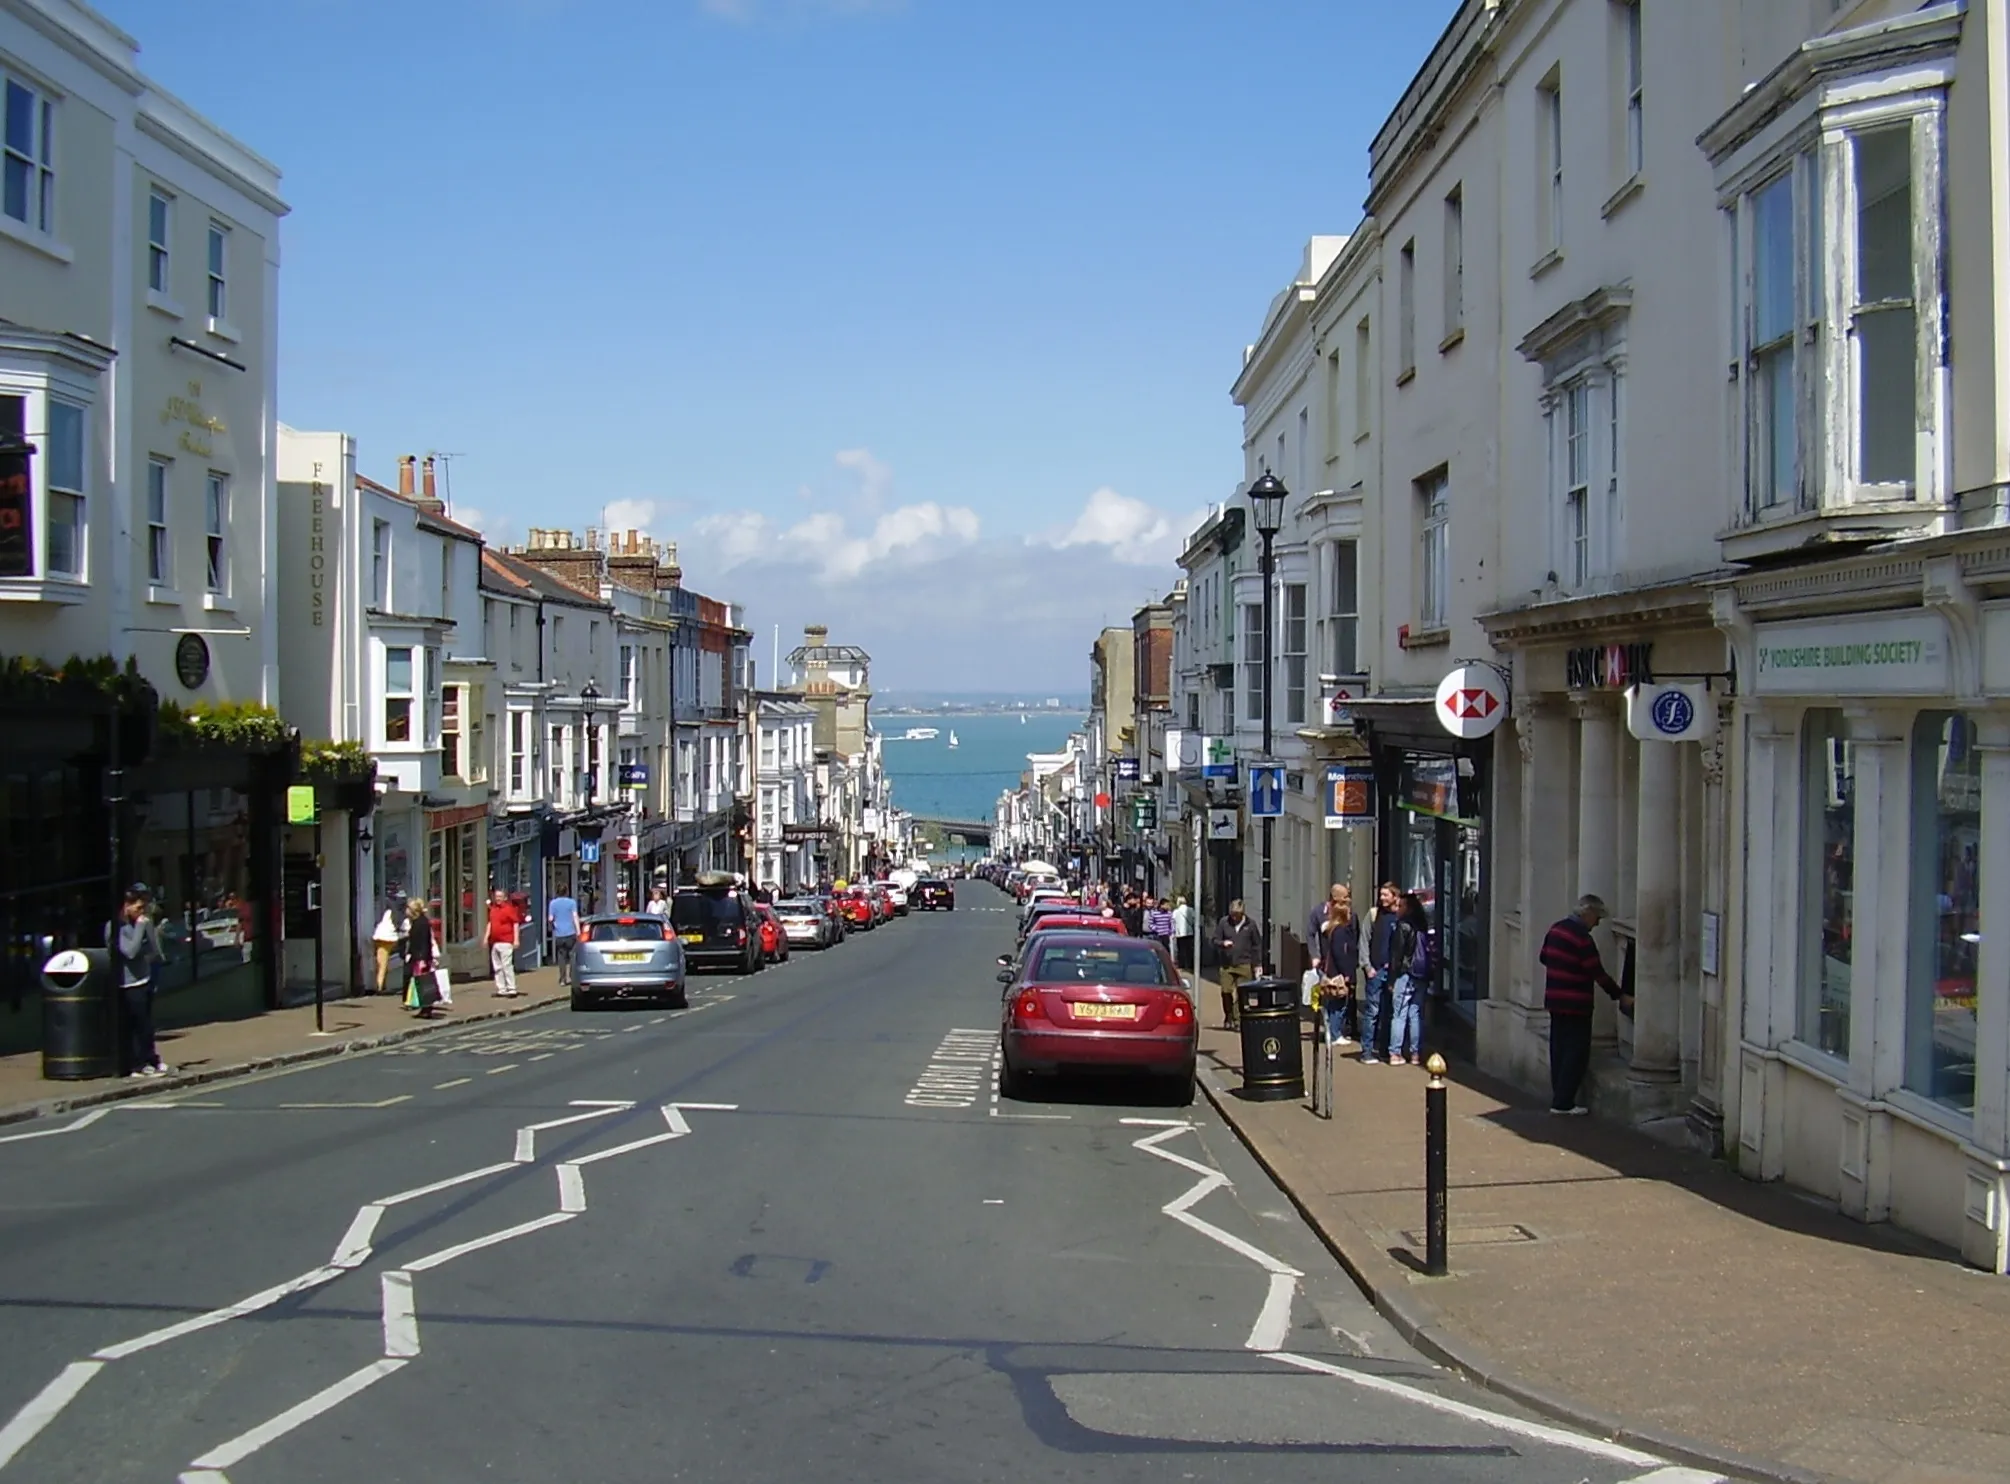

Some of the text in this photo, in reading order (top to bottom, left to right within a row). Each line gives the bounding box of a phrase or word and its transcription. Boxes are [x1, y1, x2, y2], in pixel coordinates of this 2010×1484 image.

[311, 462, 324, 627] FREEHOUSE
[1567, 646, 1605, 690] HSBC
[1770, 646, 1821, 669] YORKSHIRE
[1823, 643, 1872, 667] BUILDING
[1873, 641, 1921, 665] SOCIETY
